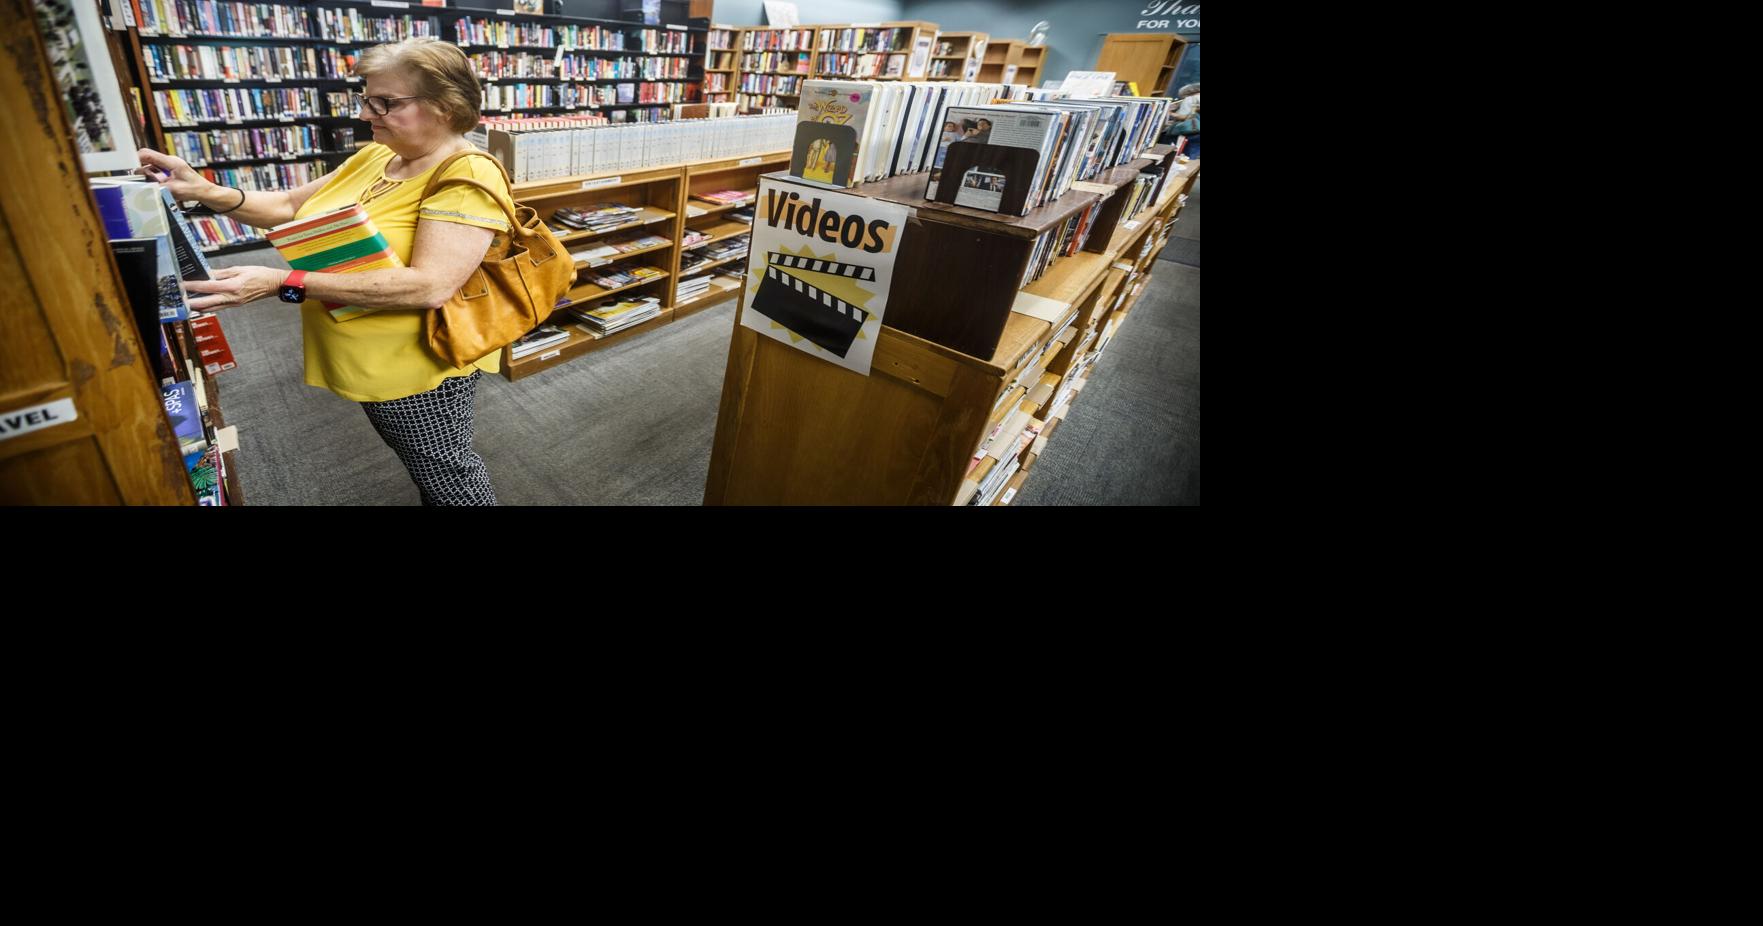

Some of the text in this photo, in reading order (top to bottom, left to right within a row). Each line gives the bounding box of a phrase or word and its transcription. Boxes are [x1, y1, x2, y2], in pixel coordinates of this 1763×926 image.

[1136, 19, 1200, 29] FOR YO
[767, 188, 890, 254] Videos
